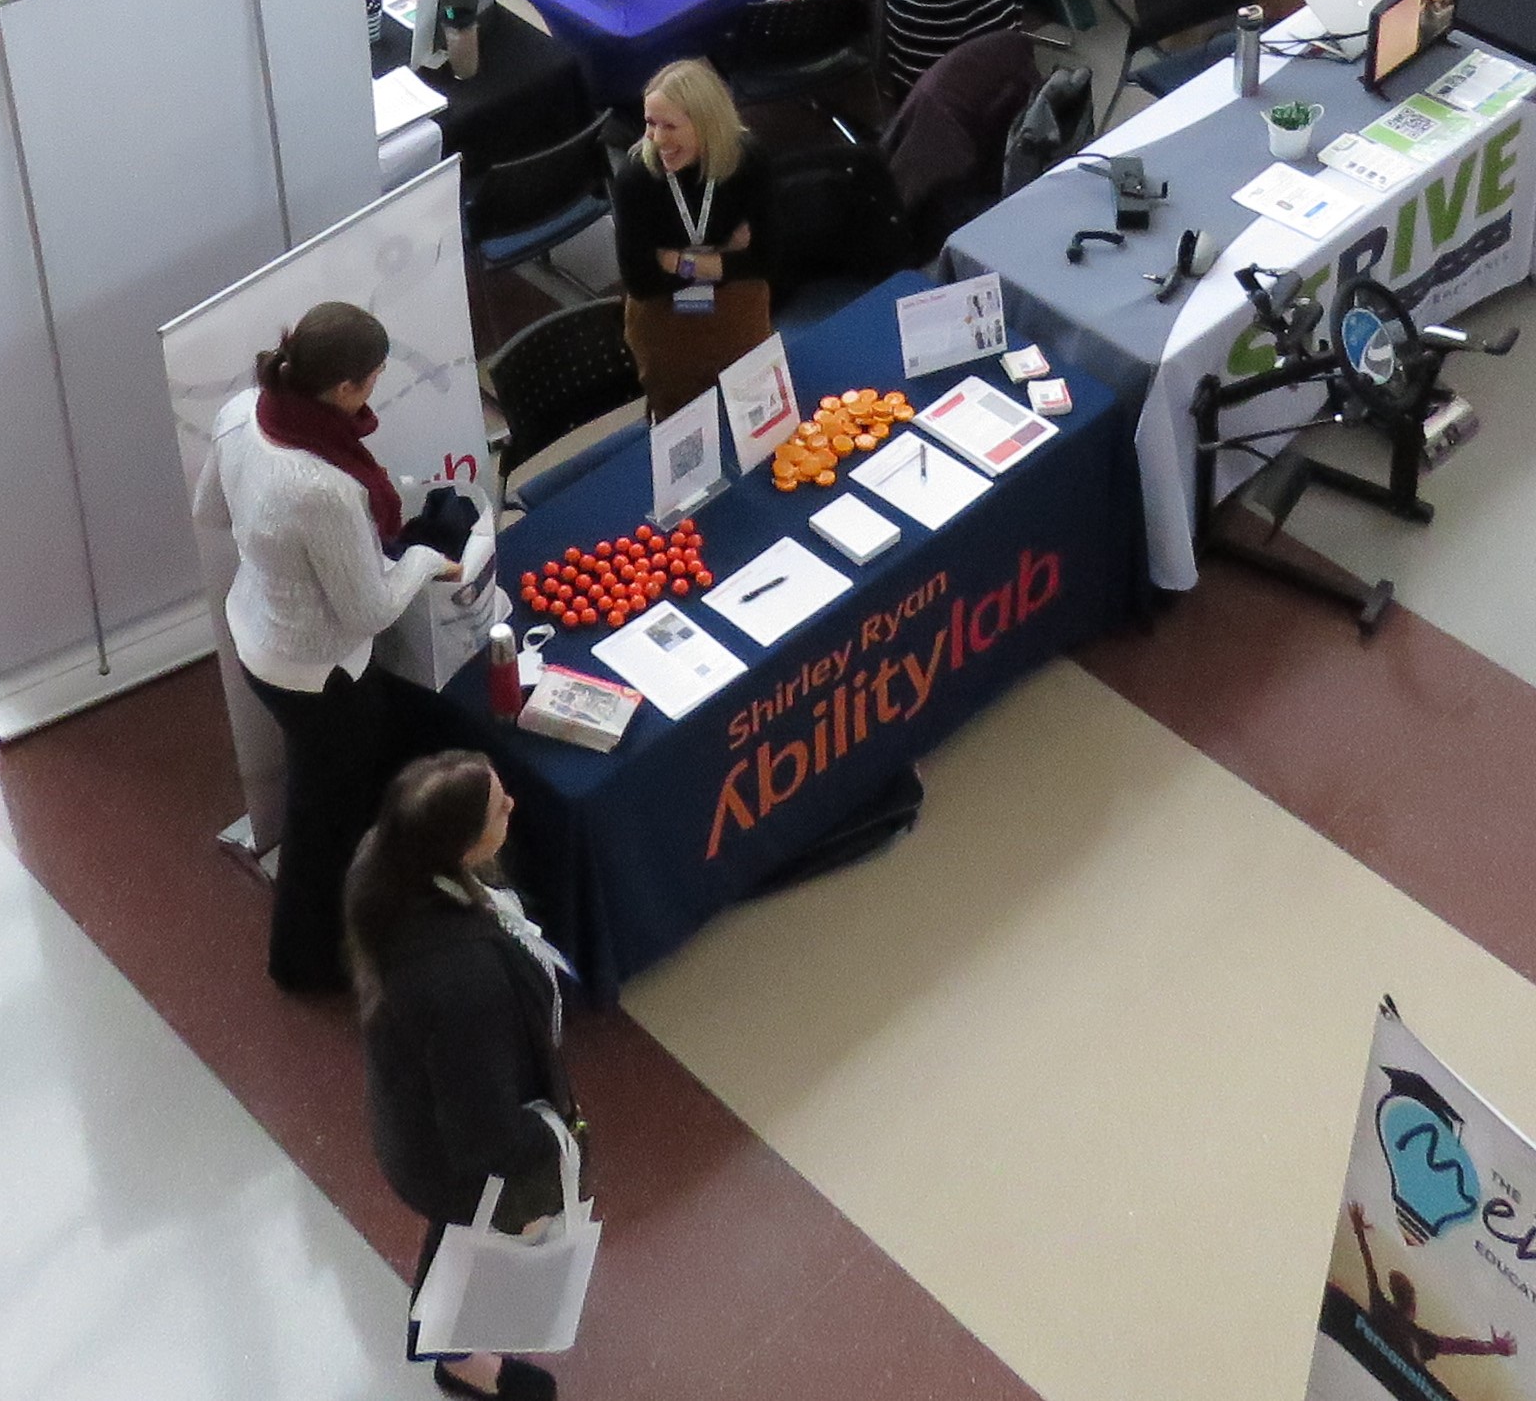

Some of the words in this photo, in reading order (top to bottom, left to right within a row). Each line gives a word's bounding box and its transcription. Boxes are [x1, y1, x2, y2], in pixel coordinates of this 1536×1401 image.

[727, 640, 852, 750] Shirley
[861, 570, 948, 652] Ryan
[1491, 1167, 1522, 1205] THE
